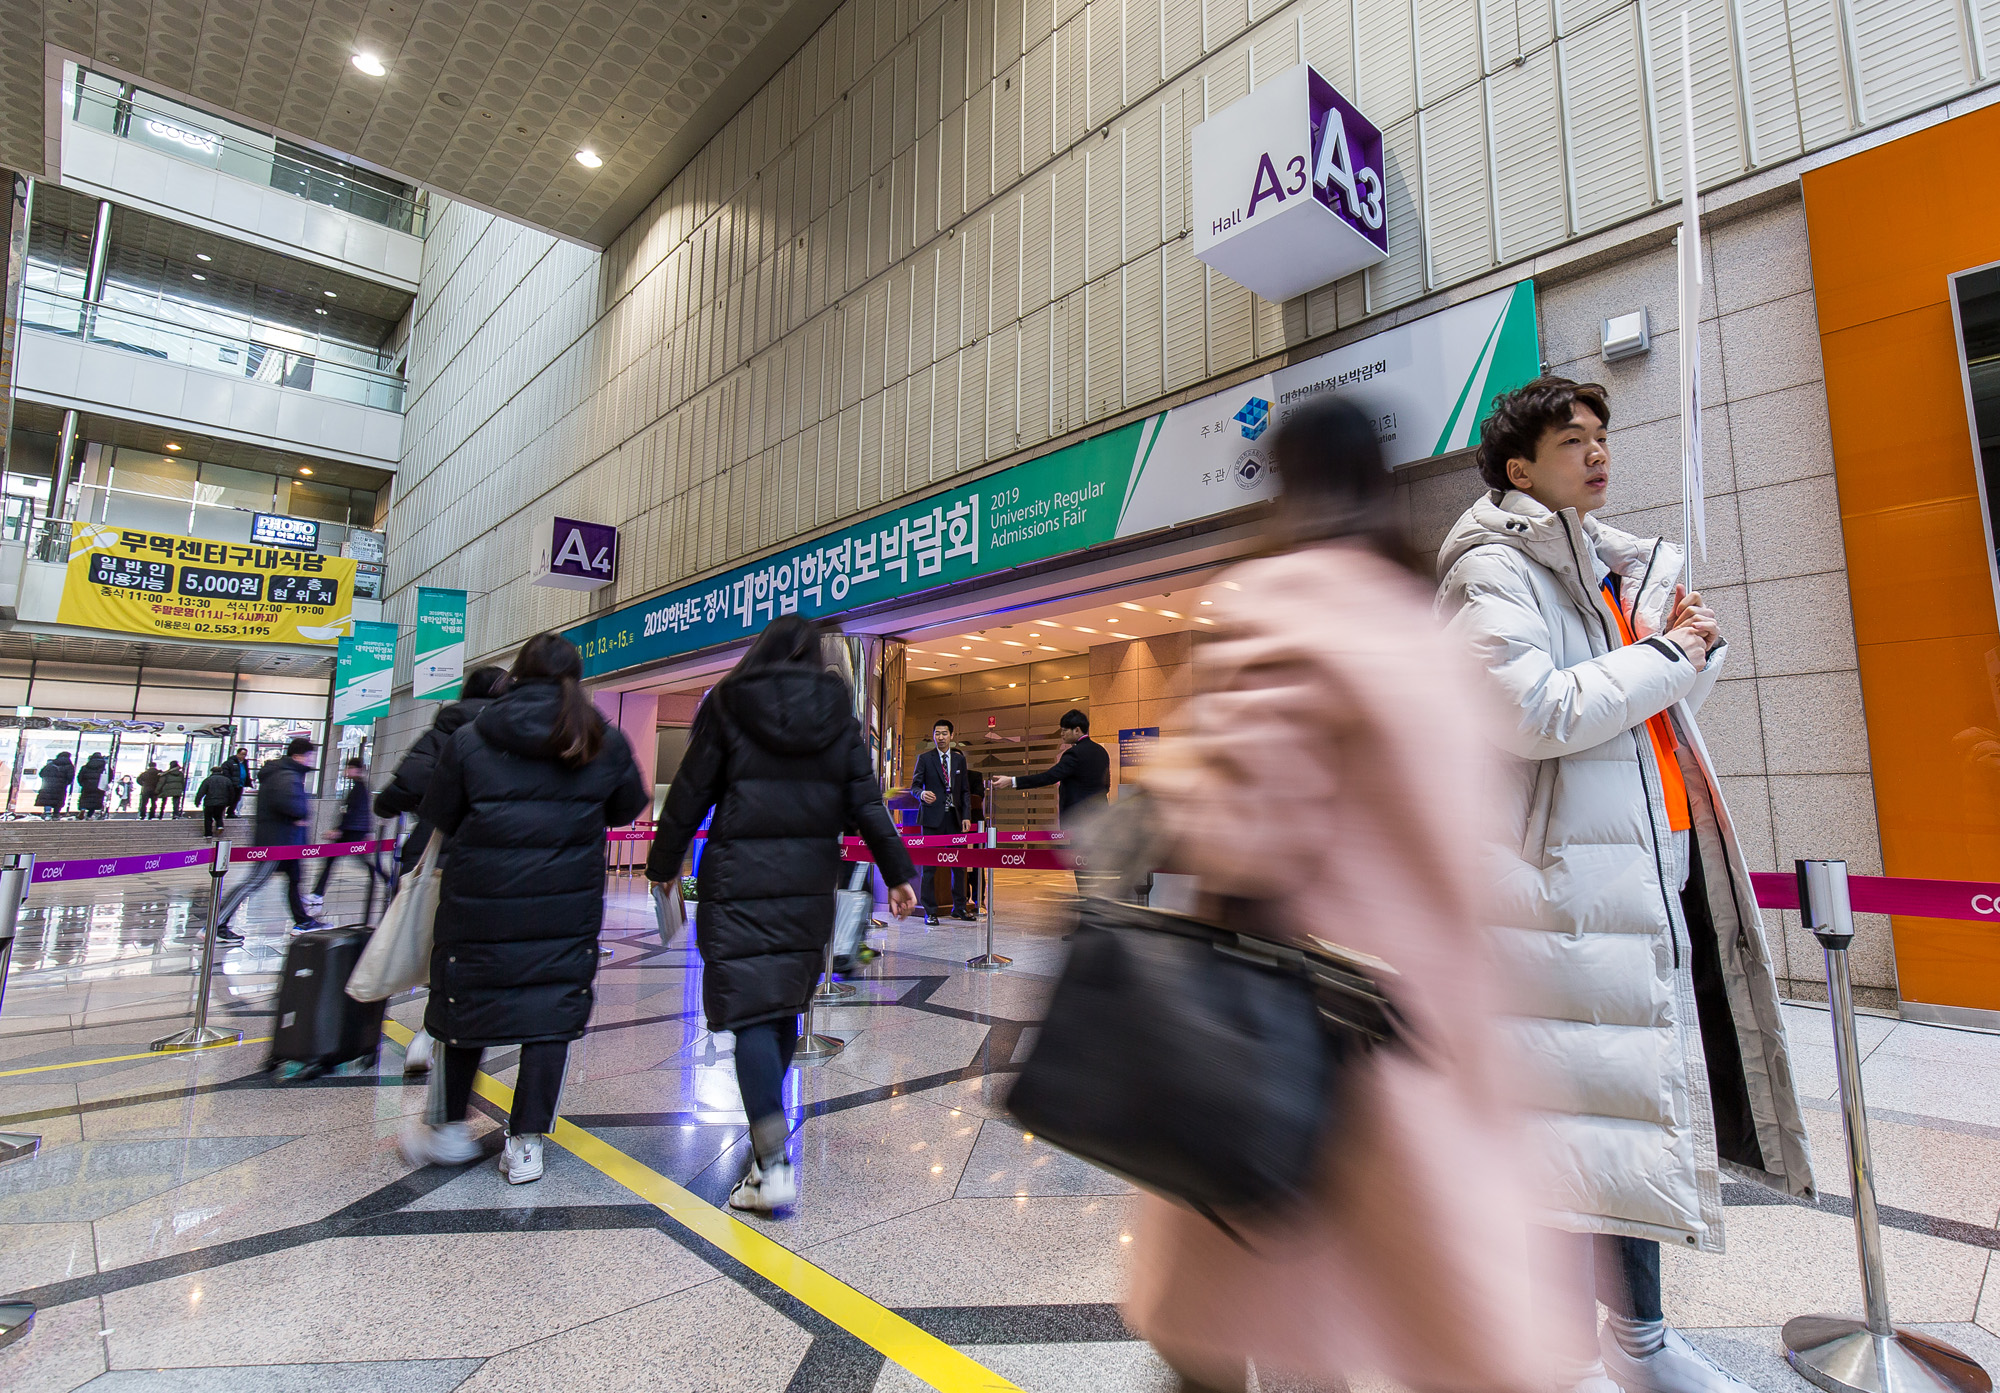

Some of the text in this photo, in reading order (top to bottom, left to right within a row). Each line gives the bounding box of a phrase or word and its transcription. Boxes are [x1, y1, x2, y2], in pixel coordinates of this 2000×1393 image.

[151, 121, 213, 150] coex
[1313, 107, 1383, 230] A3
[1212, 152, 1307, 236] Hall A3
[991, 487, 1020, 510] 2019
[991, 481, 1106, 529] University Regular
[257, 515, 317, 536] PHOTO
[990, 508, 1087, 549] Admissions Fair
[120, 531, 327, 572] 무역센터구내식당
[553, 528, 611, 573] A4
[98, 570, 165, 591] 이용가능
[185, 573, 260, 596] 5,000원
[586, 641, 596, 659] 12.
[643, 597, 702, 638] 2019학년도
[703, 585, 730, 624] 정시
[733, 493, 979, 628] 대학입학정보박람회
[100, 586, 125, 599] 중식
[129, 591, 163, 603] 11:00
[178, 597, 211, 609] 13:30
[227, 601, 249, 612] 석식
[252, 603, 282, 613] 17:00
[295, 605, 324, 615] 19:00
[194, 623, 270, 635] 02.553.1195
[908, 834, 968, 846] coex coex
[1011, 830, 1065, 841] coex coex
[184, 851, 198, 864] coex
[246, 848, 268, 859] coex
[302, 846, 321, 856] coex
[350, 843, 367, 853] coex
[937, 850, 959, 863] coex
[1001, 851, 1026, 865] coex
[41, 863, 66, 879] coex
[98, 860, 118, 875] coex
[144, 856, 161, 870] coex
